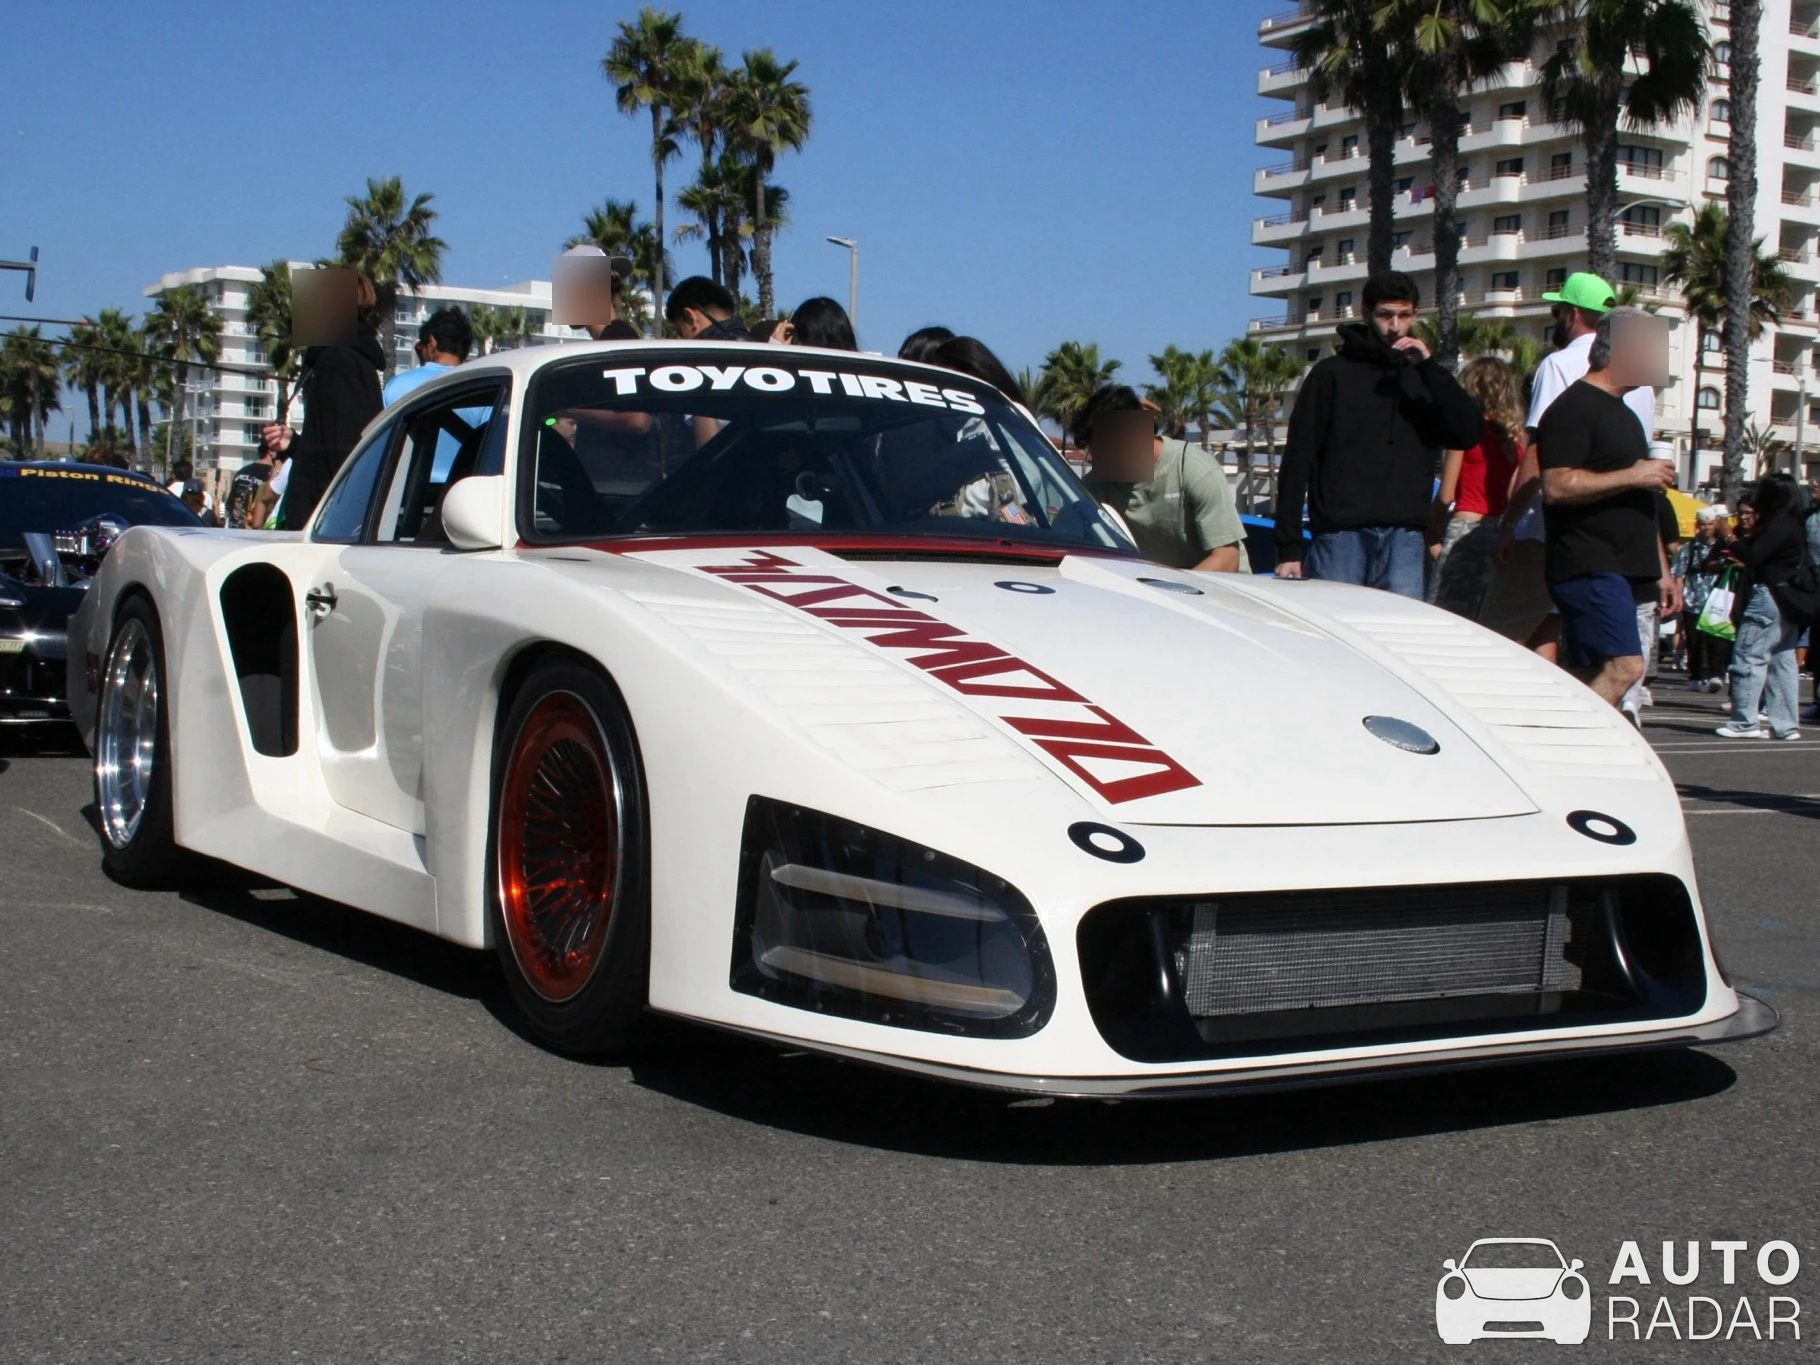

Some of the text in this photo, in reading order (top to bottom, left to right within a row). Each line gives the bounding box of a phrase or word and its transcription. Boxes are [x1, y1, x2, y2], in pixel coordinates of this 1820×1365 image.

[603, 365, 985, 415] TOYO TIRES
[20, 468, 99, 481] Piston
